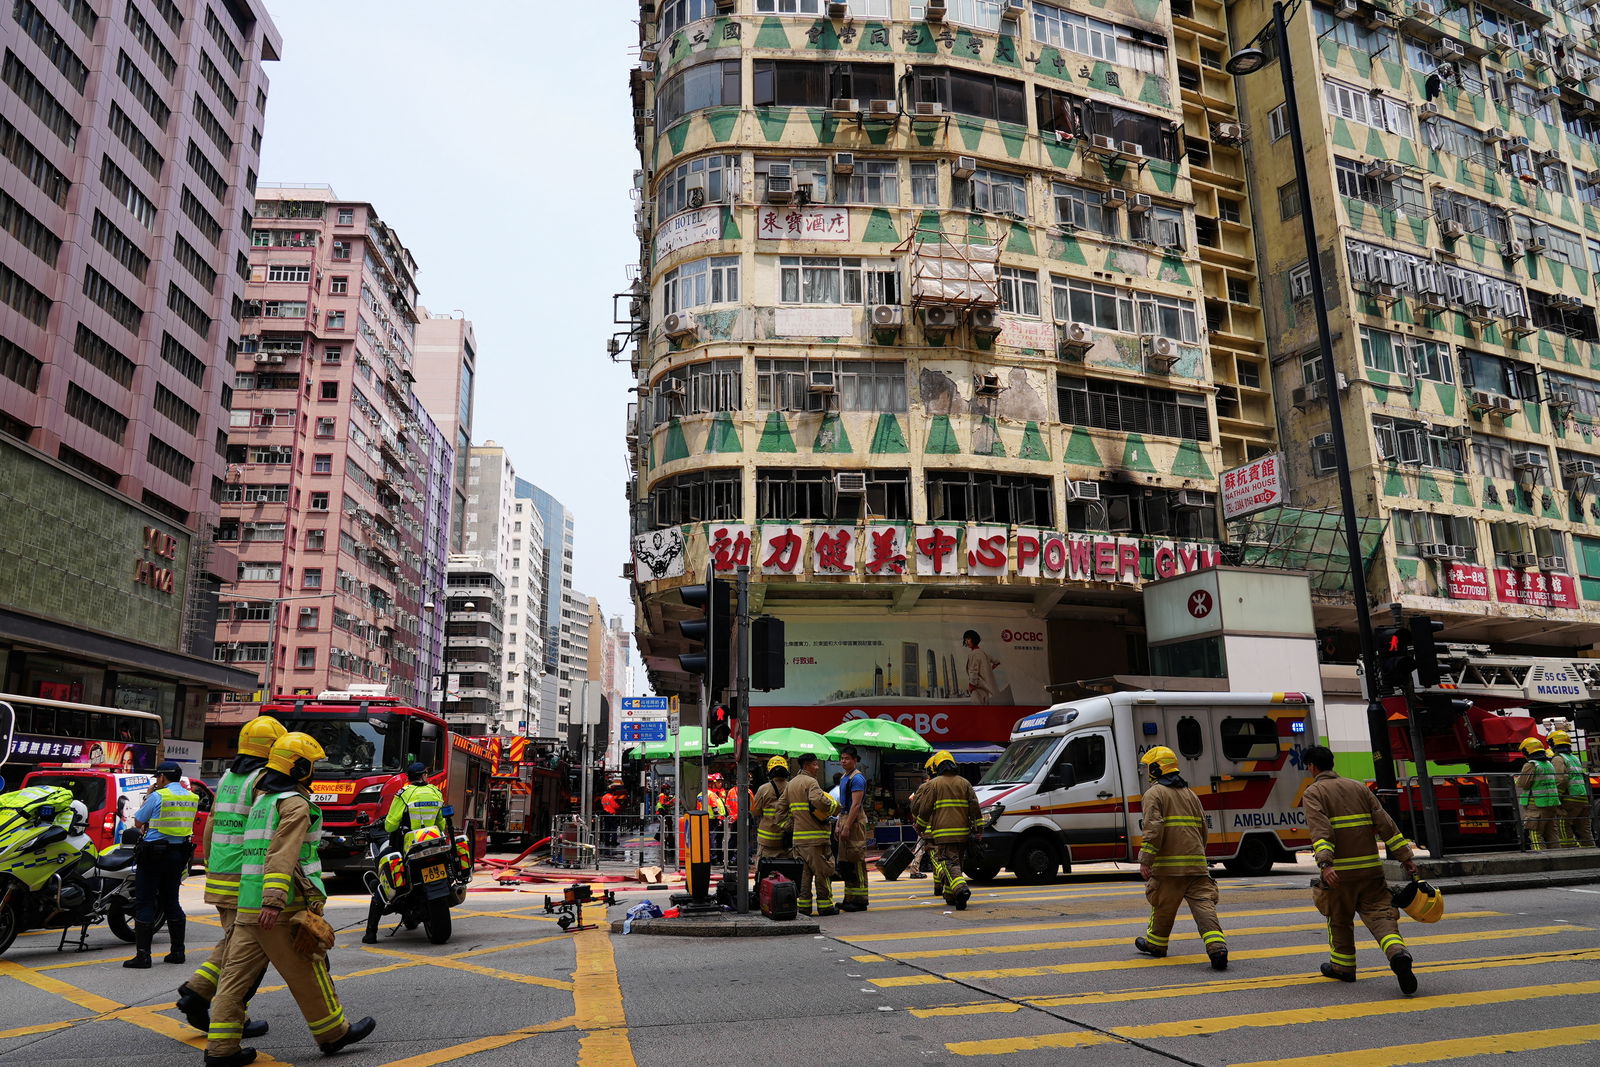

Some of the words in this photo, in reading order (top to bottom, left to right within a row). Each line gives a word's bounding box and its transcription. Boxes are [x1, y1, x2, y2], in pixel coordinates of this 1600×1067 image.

[674, 211, 704, 231] HOTEL
[762, 213, 846, 234] 東寶酒店
[1225, 458, 1275, 491] 蘇杭賓館
[1225, 486, 1250, 500] NATHAN
[1252, 477, 1276, 490] HOUSE
[143, 525, 176, 560] YUE
[1017, 535, 1140, 577] POWER
[1155, 547, 1222, 579] GYM
[134, 558, 175, 595] HWA
[1449, 568, 1486, 584] 香港一日遊
[1505, 589, 1516, 597] NEW
[1517, 591, 1533, 599] LUCKY
[1534, 592, 1550, 600] GUEST
[1551, 594, 1567, 602] HOUSE
[1014, 631, 1043, 642] OCBC
[1545, 672, 1555, 681] 55
[1556, 673, 1567, 681] CS
[1537, 685, 1580, 695] MAGIRUS
[1020, 717, 1049, 730] AMBULANCE
[222, 785, 238, 795] FIRE
[313, 784, 344, 792] SERVICES
[1234, 812, 1309, 827] AMBULANC
[424, 870, 446, 880] 7039
